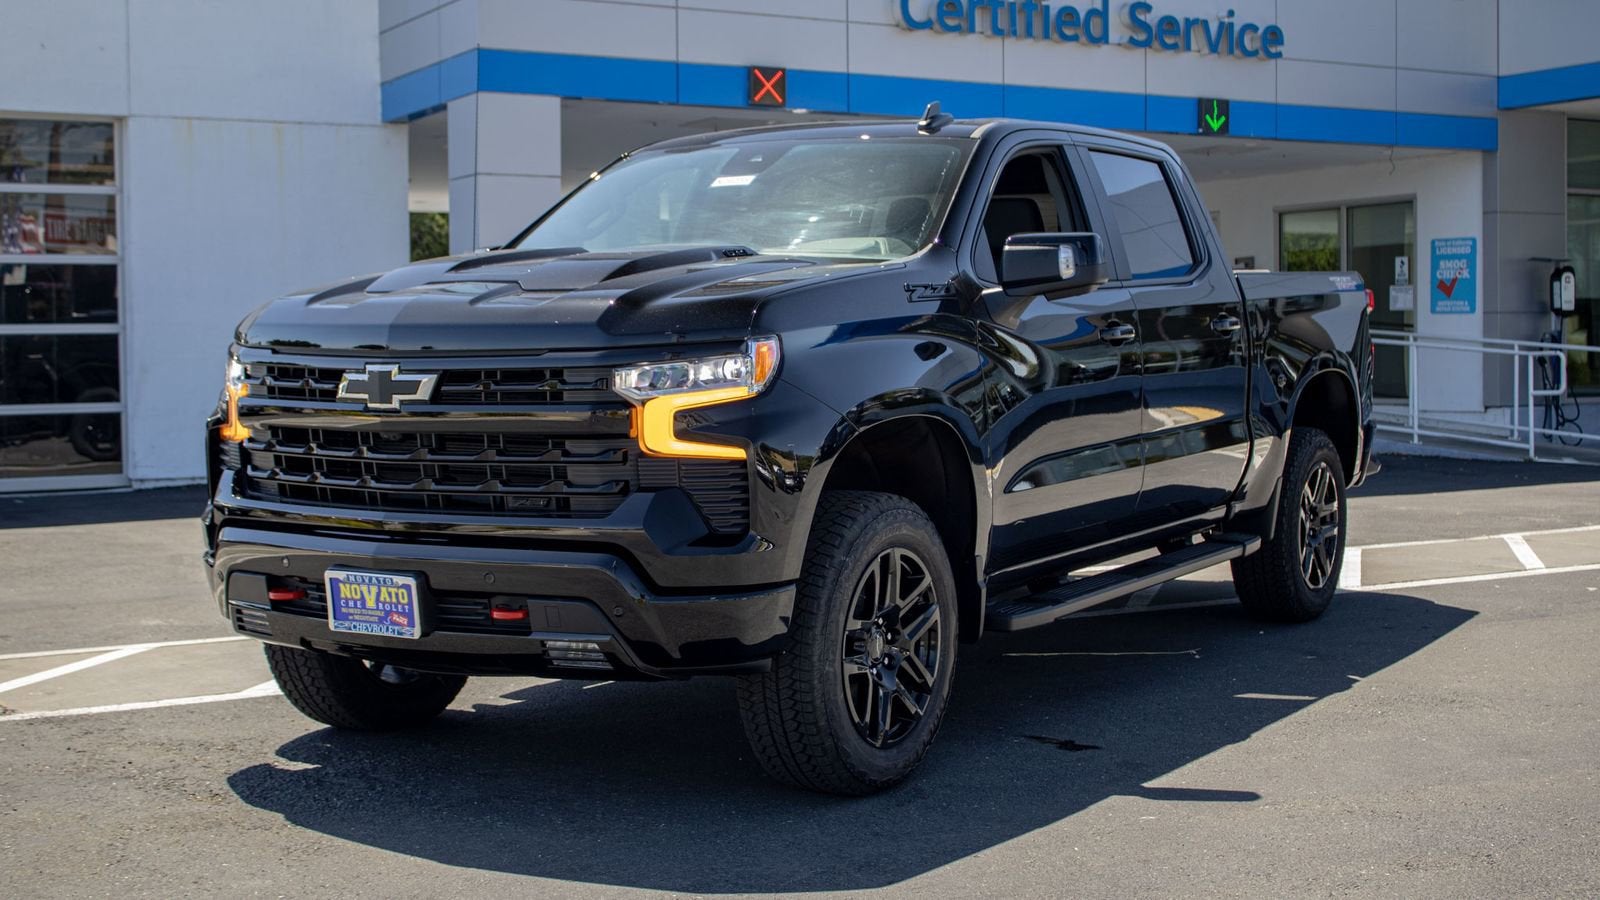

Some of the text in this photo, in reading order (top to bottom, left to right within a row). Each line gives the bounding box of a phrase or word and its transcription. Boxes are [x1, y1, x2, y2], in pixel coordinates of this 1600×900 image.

[900, 0, 1284, 59] Certified Service
[1436, 246, 1471, 255] LICENSED
[1440, 259, 1467, 269] SMOG
[1436, 269, 1470, 279] CHECK
[349, 575, 392, 584] NOVATO
[339, 583, 409, 609] NOVATO
[351, 623, 398, 634] CHEVROLET
